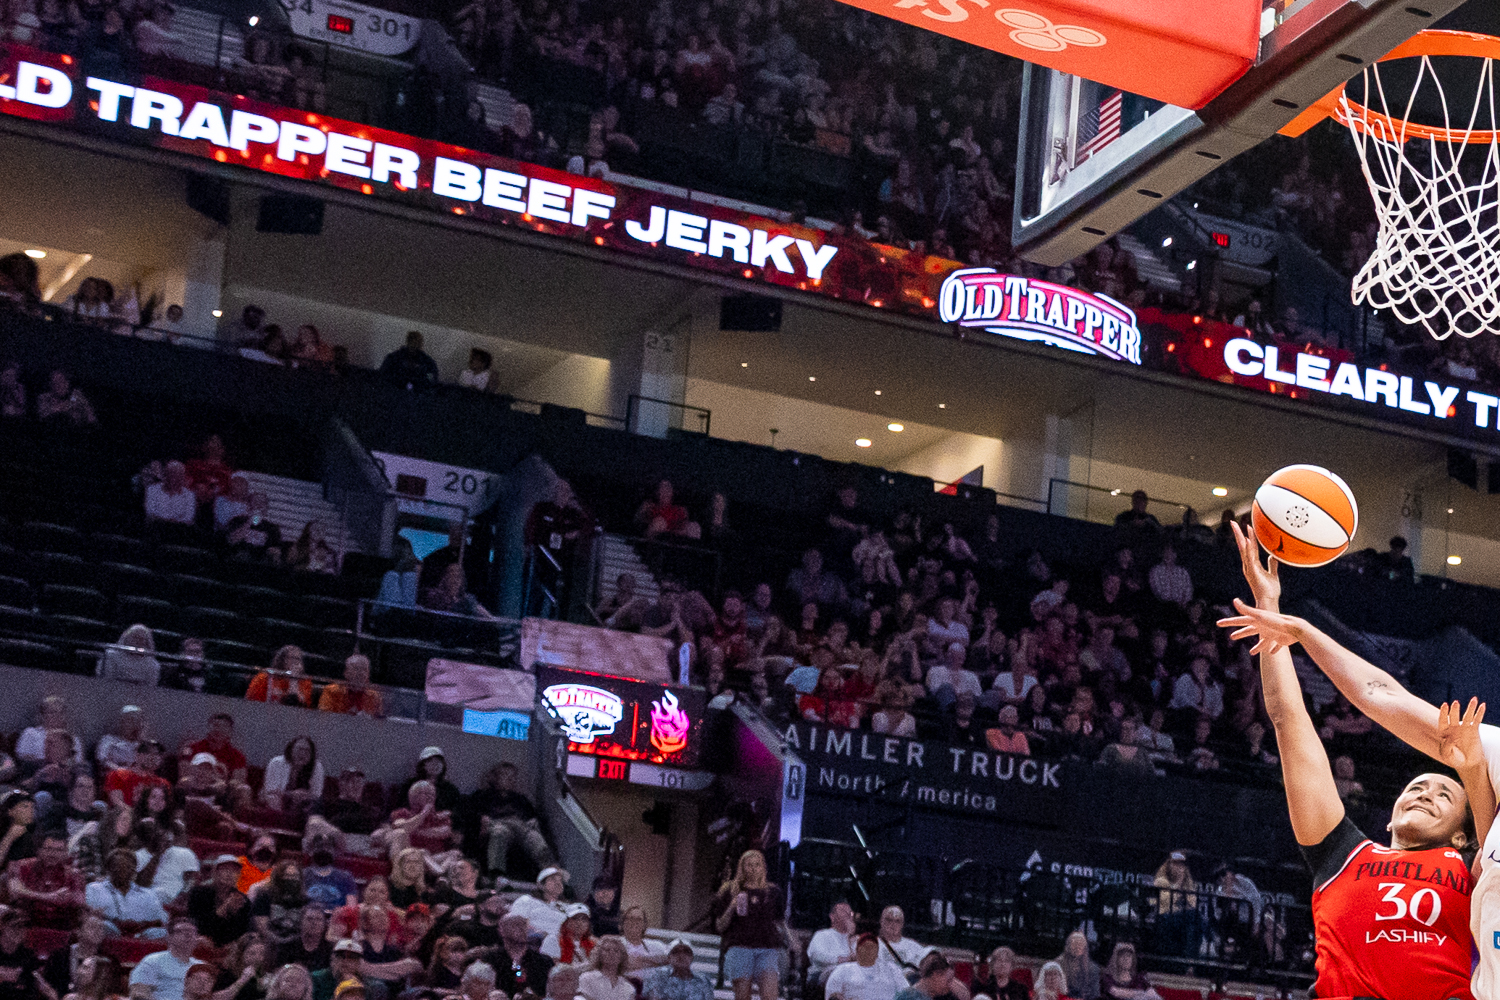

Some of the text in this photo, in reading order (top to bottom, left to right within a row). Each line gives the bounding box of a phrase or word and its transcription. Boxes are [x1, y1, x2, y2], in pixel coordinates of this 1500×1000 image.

[367, 14, 411, 41] 301
[87, 76, 419, 189] TRAPPER
[433, 157, 616, 227] BEEF
[626, 205, 838, 279] JERKY
[943, 276, 1139, 364] OLD TRAPPER
[1223, 338, 1460, 419] CLEARLY
[444, 471, 491, 497] 201
[599, 761, 627, 780] EXIT
[658, 771, 686, 788] 101
[819, 767, 886, 794] North
[950, 747, 1062, 788] TRUCK
[1375, 882, 1442, 927] 30
[1366, 929, 1447, 946] LASHIFY
